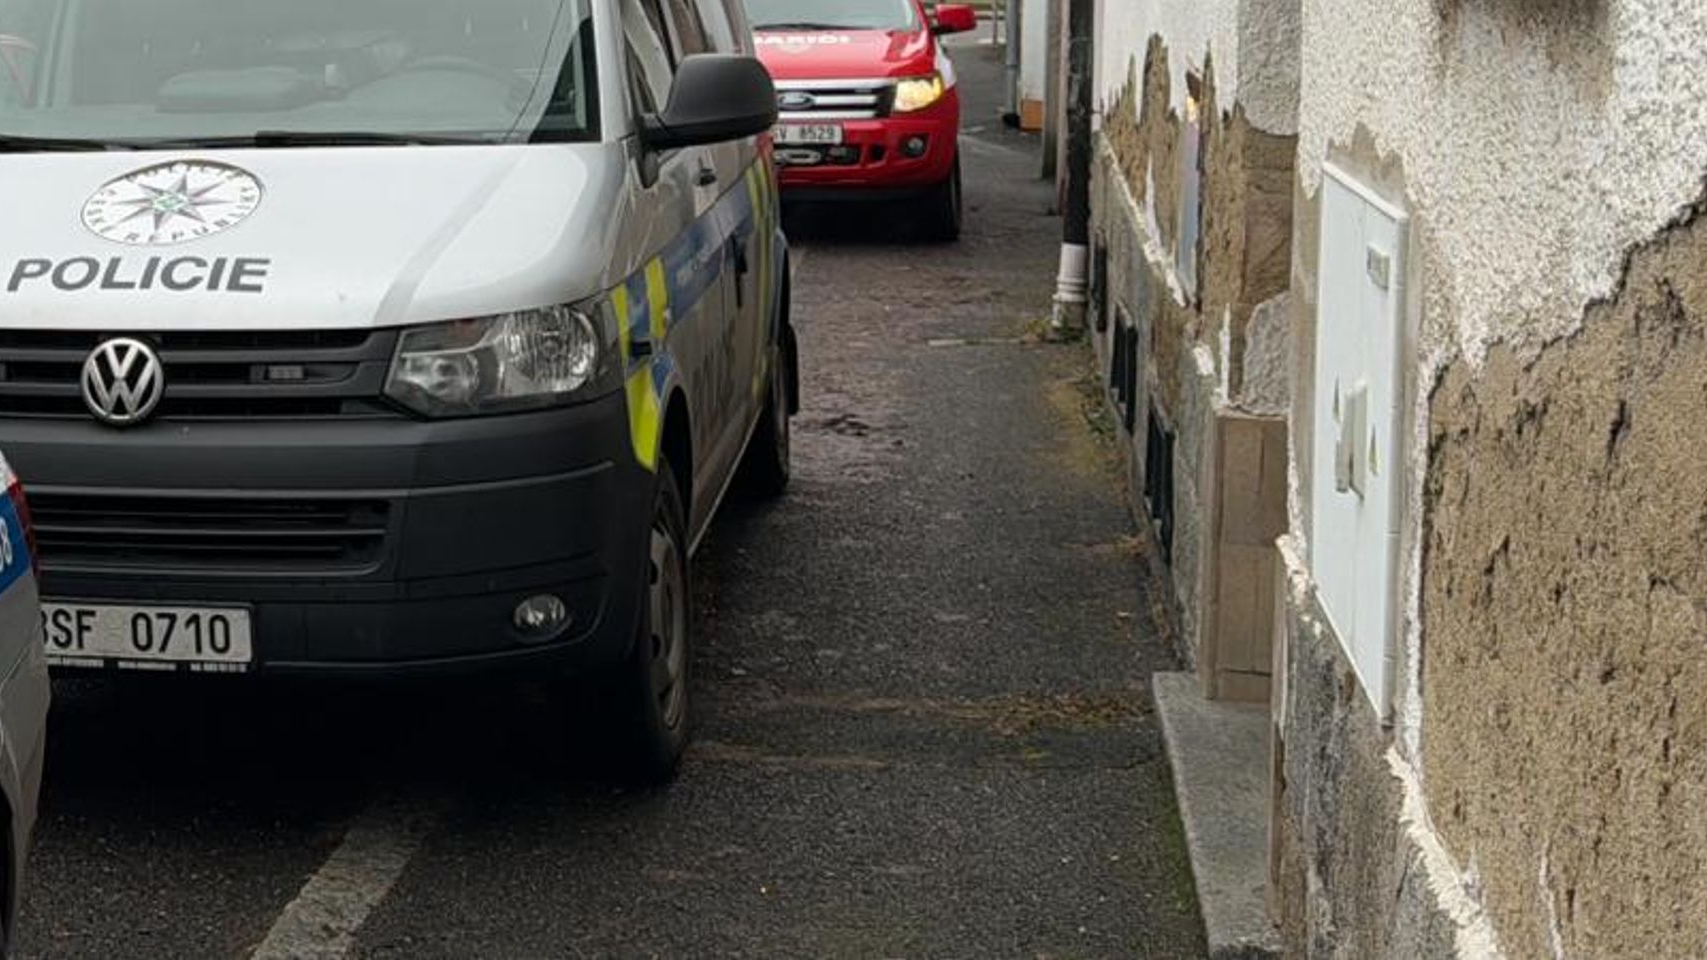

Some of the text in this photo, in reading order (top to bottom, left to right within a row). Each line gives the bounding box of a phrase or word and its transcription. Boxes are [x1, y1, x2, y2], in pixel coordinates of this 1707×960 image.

[6, 255, 272, 293] POLICIE
[81, 337, 164, 421] VW
[130, 611, 231, 655] 0710
